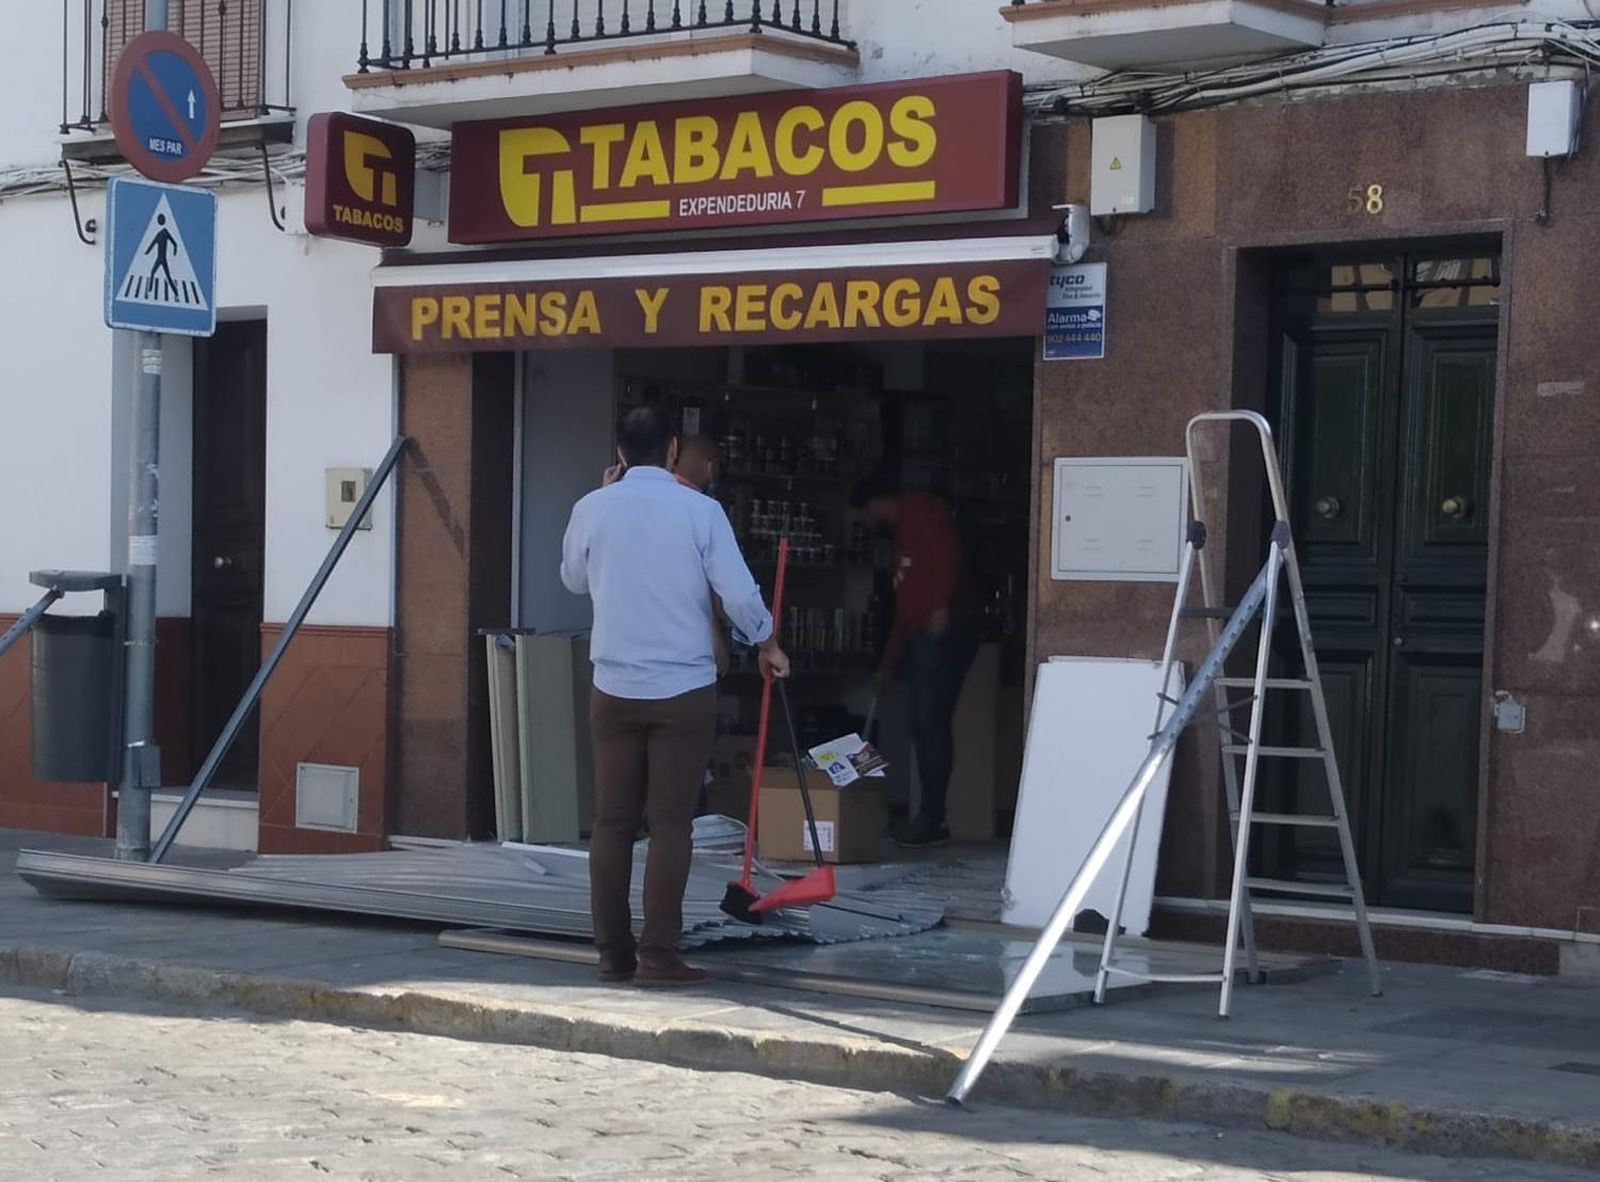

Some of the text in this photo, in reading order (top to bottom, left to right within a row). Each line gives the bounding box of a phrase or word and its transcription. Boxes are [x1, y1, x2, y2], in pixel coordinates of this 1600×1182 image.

[149, 138, 183, 155] MES PAR
[580, 95, 937, 189] TABACOS
[679, 190, 807, 217] EXPENDEDURIA 7
[332, 203, 405, 234] TABACOS
[410, 275, 1001, 342] PRENSA Y RECARGAS
[1047, 312, 1087, 323] Alarma
